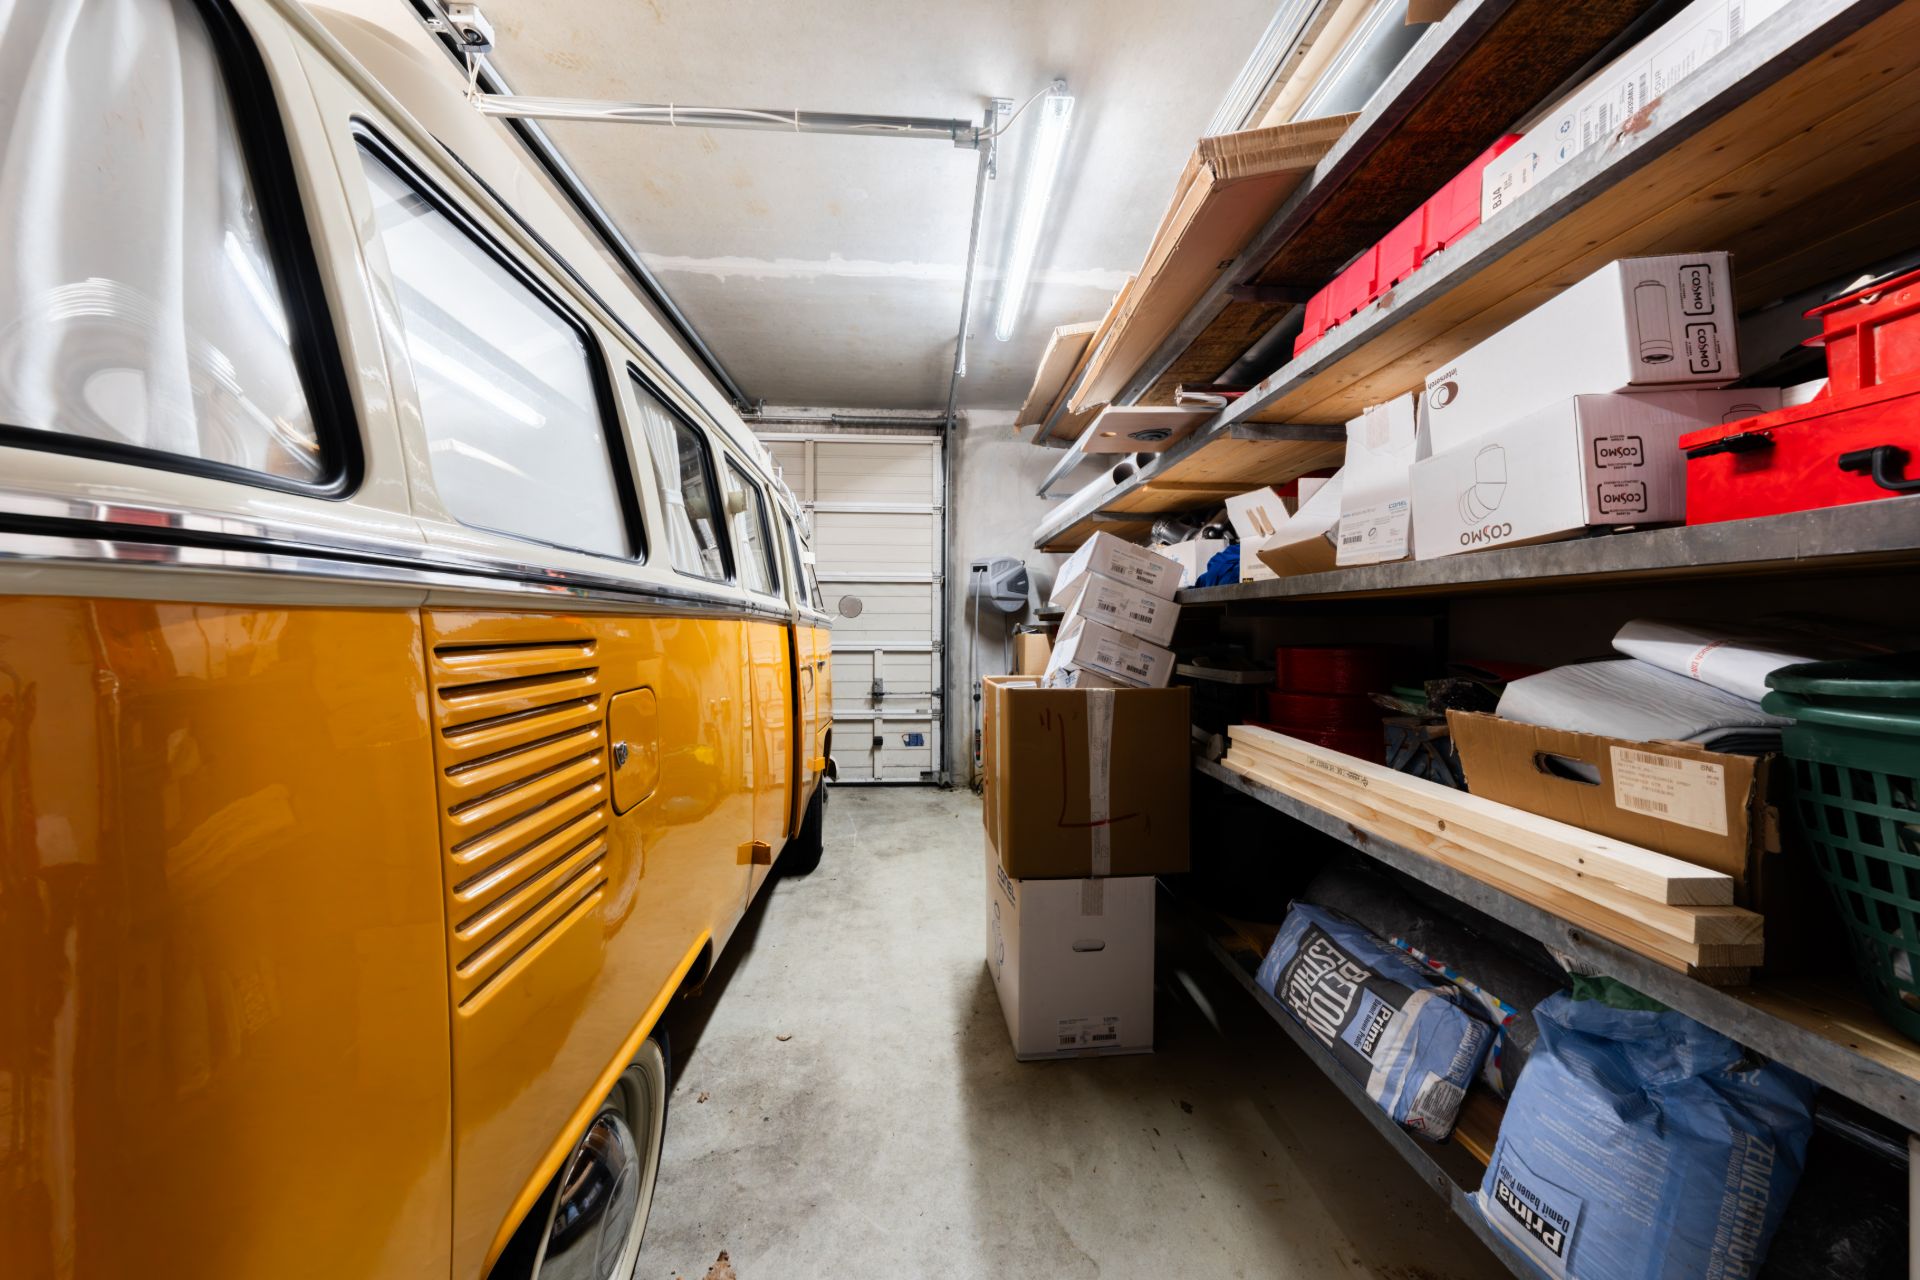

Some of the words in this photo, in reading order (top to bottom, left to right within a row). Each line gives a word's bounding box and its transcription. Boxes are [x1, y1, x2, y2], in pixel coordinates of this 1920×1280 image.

[1691, 270, 1703, 310] COSMO
[1697, 328, 1710, 368] COSMO
[1600, 446, 1638, 458] COSMO
[1603, 492, 1642, 504] COSMO
[1460, 521, 1513, 546] COSMO
[1288, 937, 1347, 1021] ESTRICH
[1305, 960, 1372, 1048] BETON
[1363, 1007, 1392, 1053] Prima
[1515, 1180, 1542, 1211] bauen
[1498, 1182, 1562, 1253] Prima
[1541, 1202, 1571, 1234] Damit
